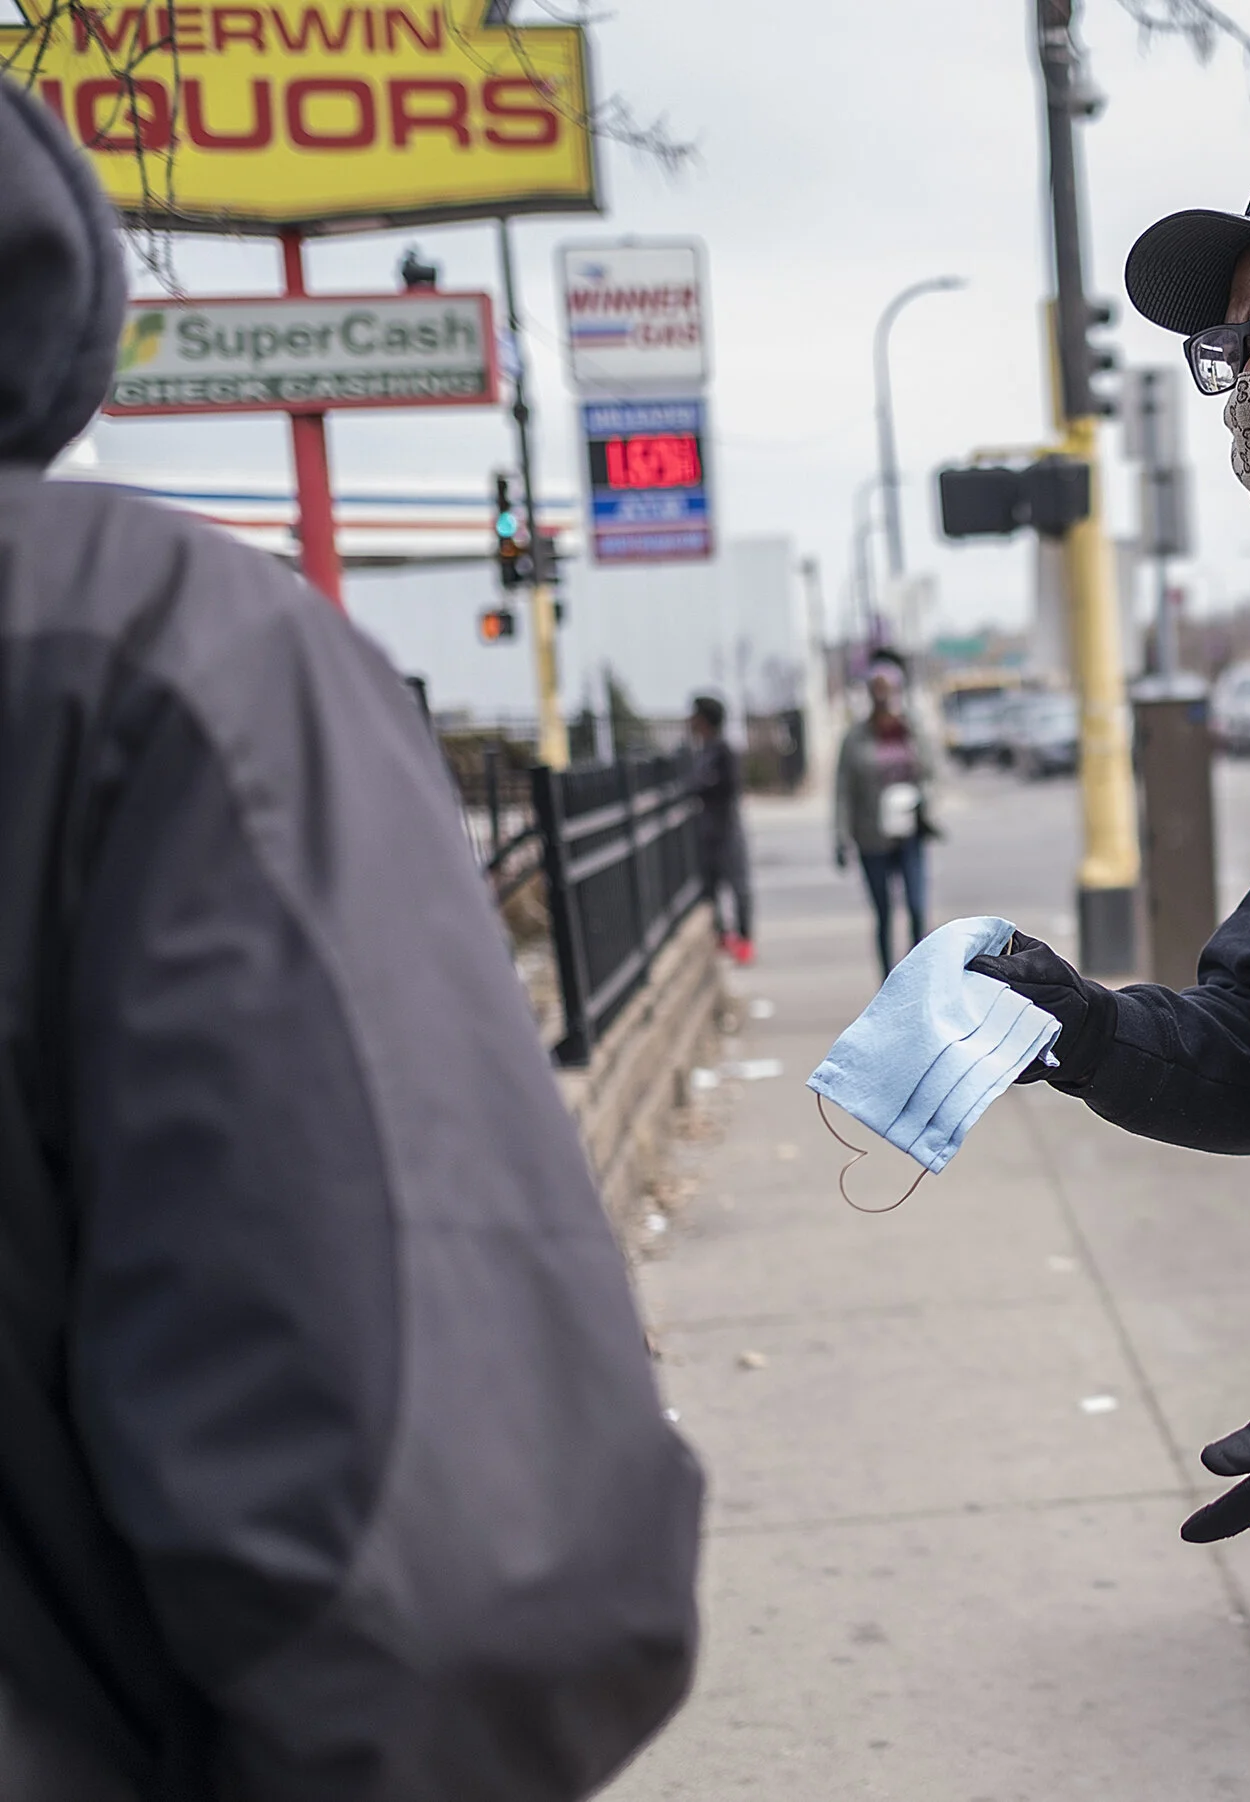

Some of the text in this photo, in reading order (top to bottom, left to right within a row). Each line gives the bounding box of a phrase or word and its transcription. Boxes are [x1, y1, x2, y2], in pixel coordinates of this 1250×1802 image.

[72, 5, 444, 53] MERWIN
[40, 78, 560, 151] IQUORS
[177, 310, 477, 367] SuperCash
[115, 369, 481, 407] CHECK CASHING
